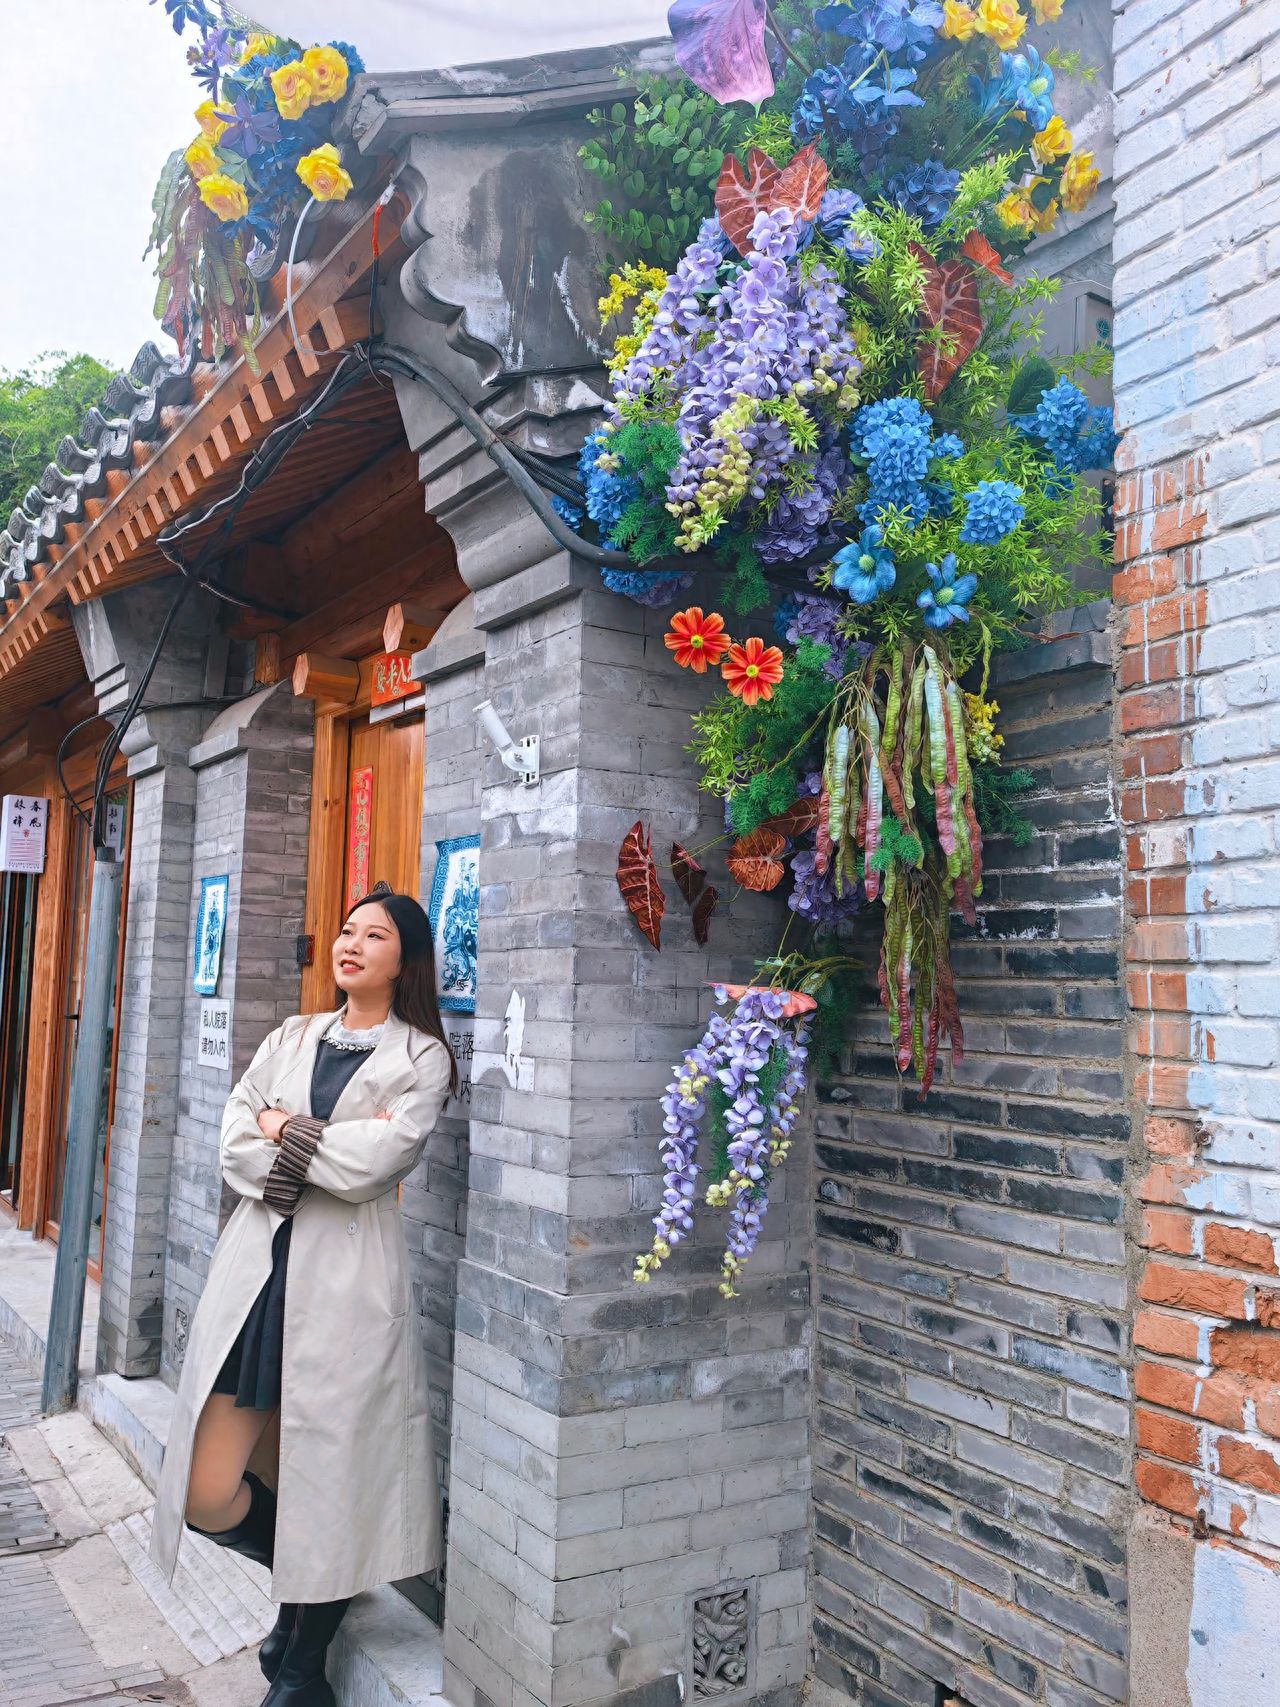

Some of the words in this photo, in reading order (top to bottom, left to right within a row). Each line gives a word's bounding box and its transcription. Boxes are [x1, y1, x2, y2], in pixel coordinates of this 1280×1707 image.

[203, 1010, 228, 1029] 私人院落
[202, 1037, 226, 1058] 请勿入内
[449, 1032, 474, 1061] 院落
